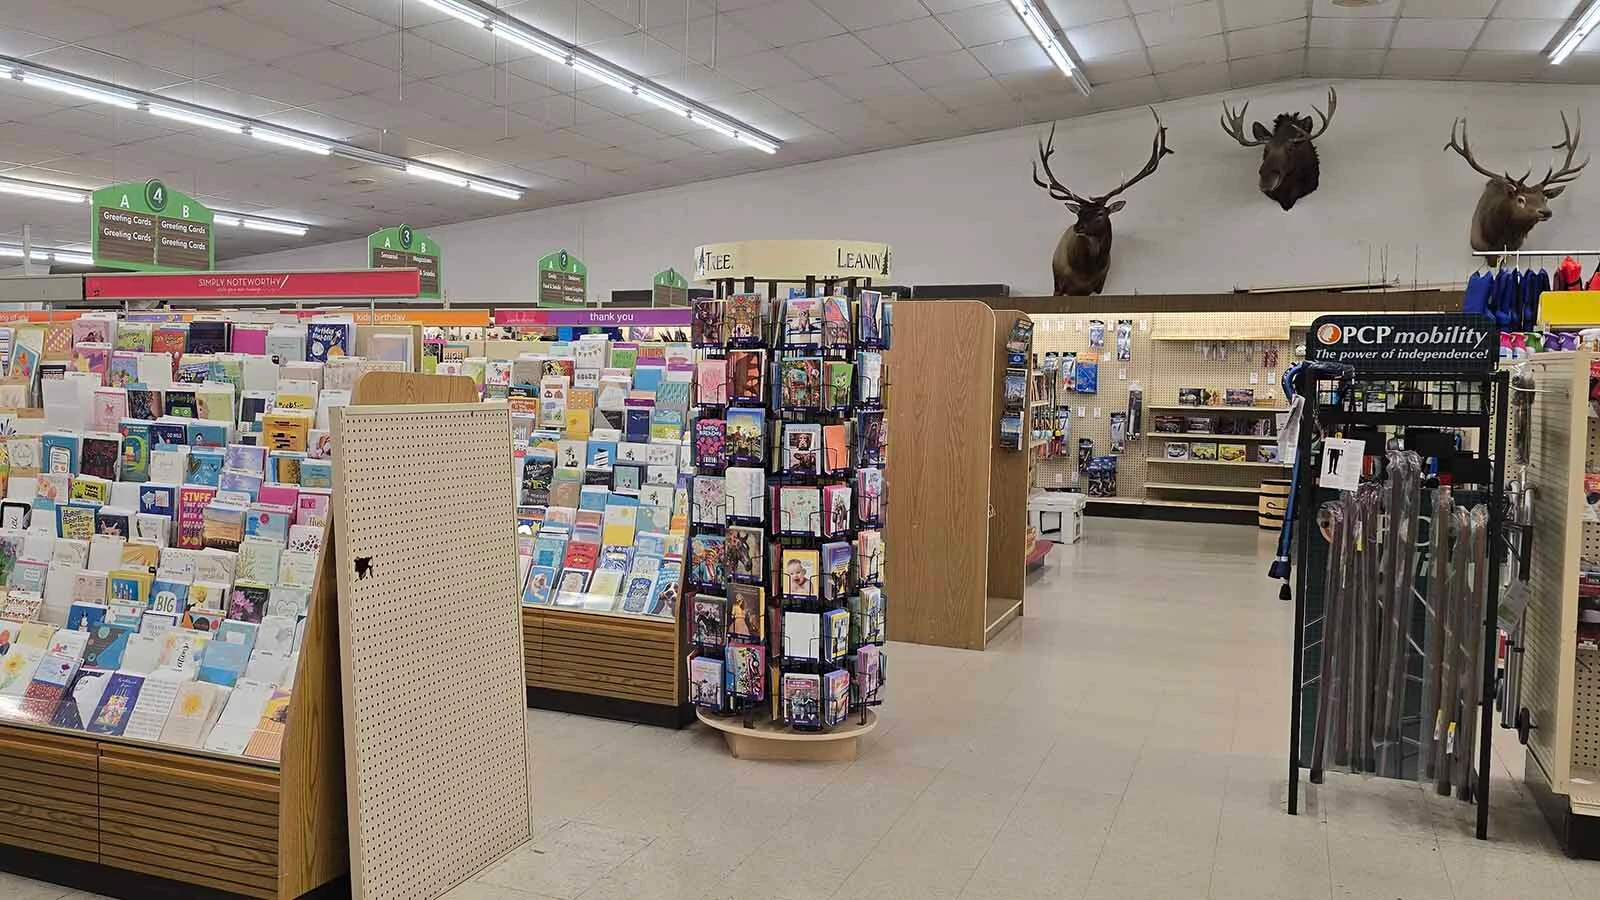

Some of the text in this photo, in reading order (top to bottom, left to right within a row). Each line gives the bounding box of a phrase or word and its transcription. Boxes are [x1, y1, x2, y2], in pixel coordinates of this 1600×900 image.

[120, 194, 130, 209] A
[153, 187, 163, 203] 4
[182, 205, 190, 218] B
[104, 211, 152, 226] Greeting Cards
[161, 221, 206, 234] Greeting Cards
[104, 228, 152, 242] Greeting Cards
[404, 230, 410, 243] 3
[161, 237, 206, 251] Greeting Cards
[384, 237, 391, 248] A
[421, 242, 426, 253] B
[198, 277, 281, 287] SIMPLY NOTEWORTHY
[590, 311, 634, 323] thank you
[1343, 326, 1488, 349] PCP mobility
[1315, 348, 1489, 362] The power of independence!
[183, 491, 212, 502] STUFF
[157, 594, 175, 613] BIG
